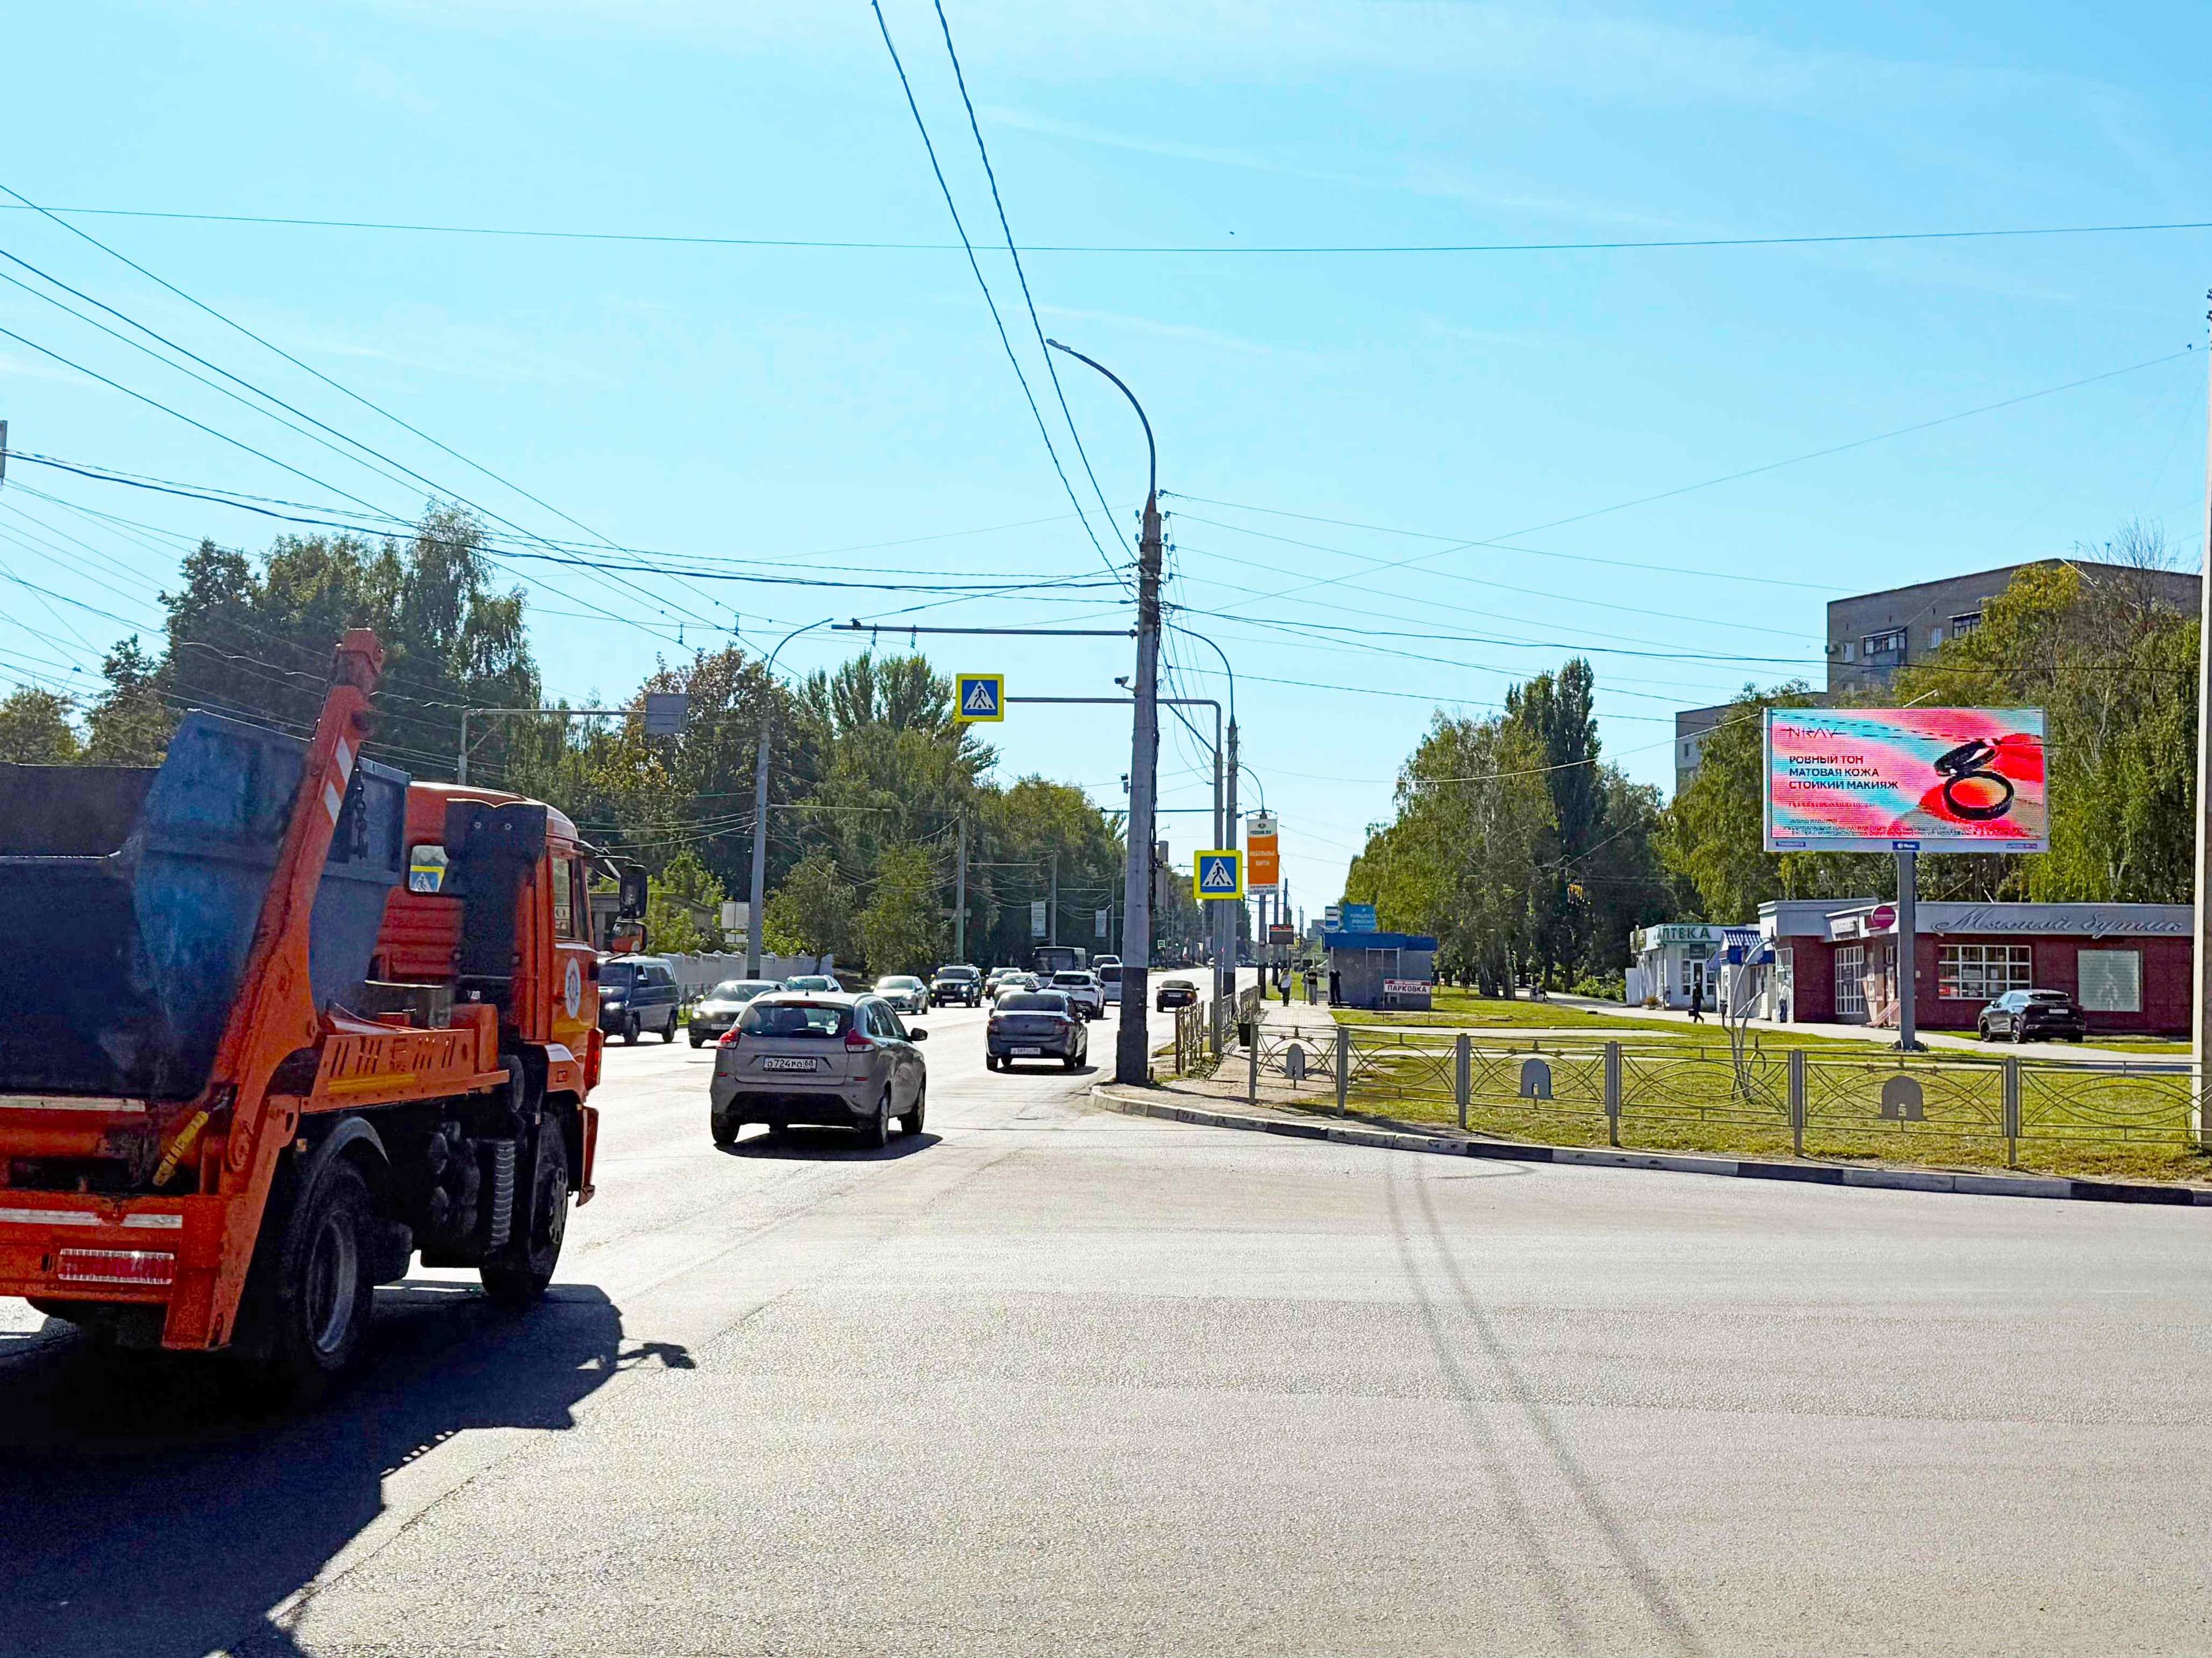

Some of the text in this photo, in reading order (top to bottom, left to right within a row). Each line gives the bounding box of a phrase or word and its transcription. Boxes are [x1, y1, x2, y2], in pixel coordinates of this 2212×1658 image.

[1789, 755, 1864, 764] РОВНЫЙ ТОН
[1789, 768, 1880, 777] МАТОВАЯ КОЖА
[1847, 780, 1899, 790] МАКИЯЖ
[1931, 906, 2183, 940] Мясной бутик
[1657, 927, 1711, 940] АПТЕКА
[1387, 984, 1427, 992] ПАРКОВКА
